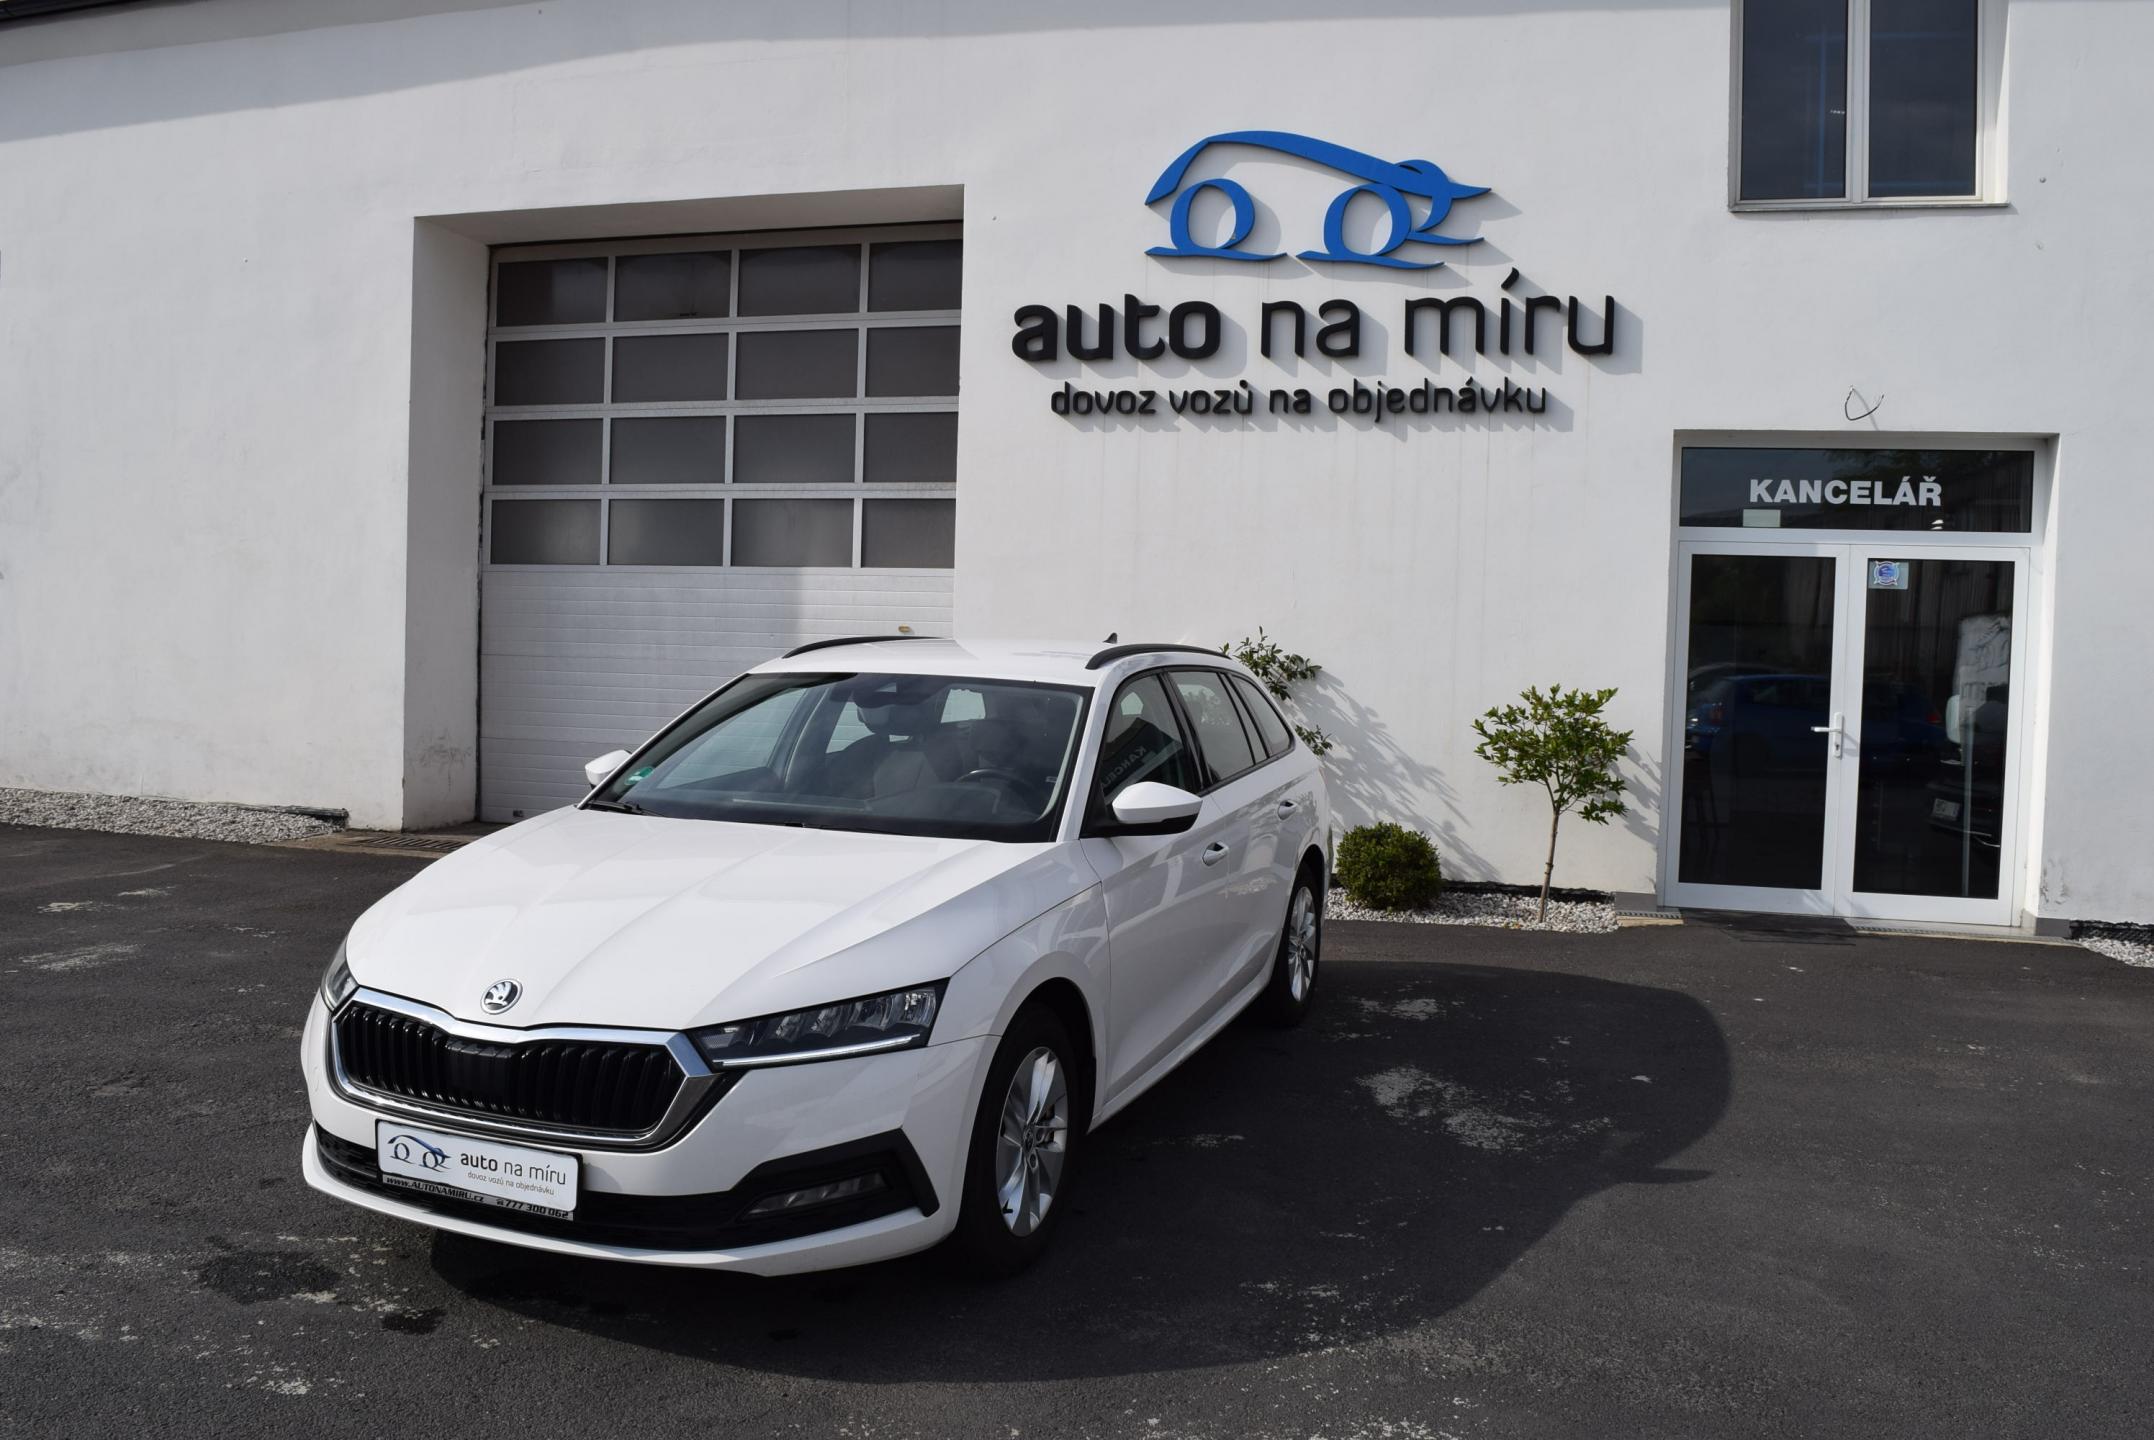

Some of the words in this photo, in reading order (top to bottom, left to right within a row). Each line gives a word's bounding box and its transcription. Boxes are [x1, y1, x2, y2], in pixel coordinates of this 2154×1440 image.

[1011, 293, 1222, 363] auto
[1260, 299, 1361, 359] na
[1404, 267, 1615, 358] míru
[1051, 381, 1157, 416] dovoz
[1168, 379, 1254, 416] vozů
[1268, 389, 1312, 415] na
[1328, 376, 1547, 424] objednávku
[1749, 475, 1942, 507] KANCELÁŘ
[460, 1152, 499, 1172] auto
[504, 1162, 523, 1177] na
[529, 1164, 566, 1185] míru
[467, 1171, 487, 1182] dovoz
[505, 1180, 515, 1188] na
[515, 1181, 555, 1195] objednávku
[526, 1203, 546, 1215] 300
[548, 1208, 569, 1220] 062
